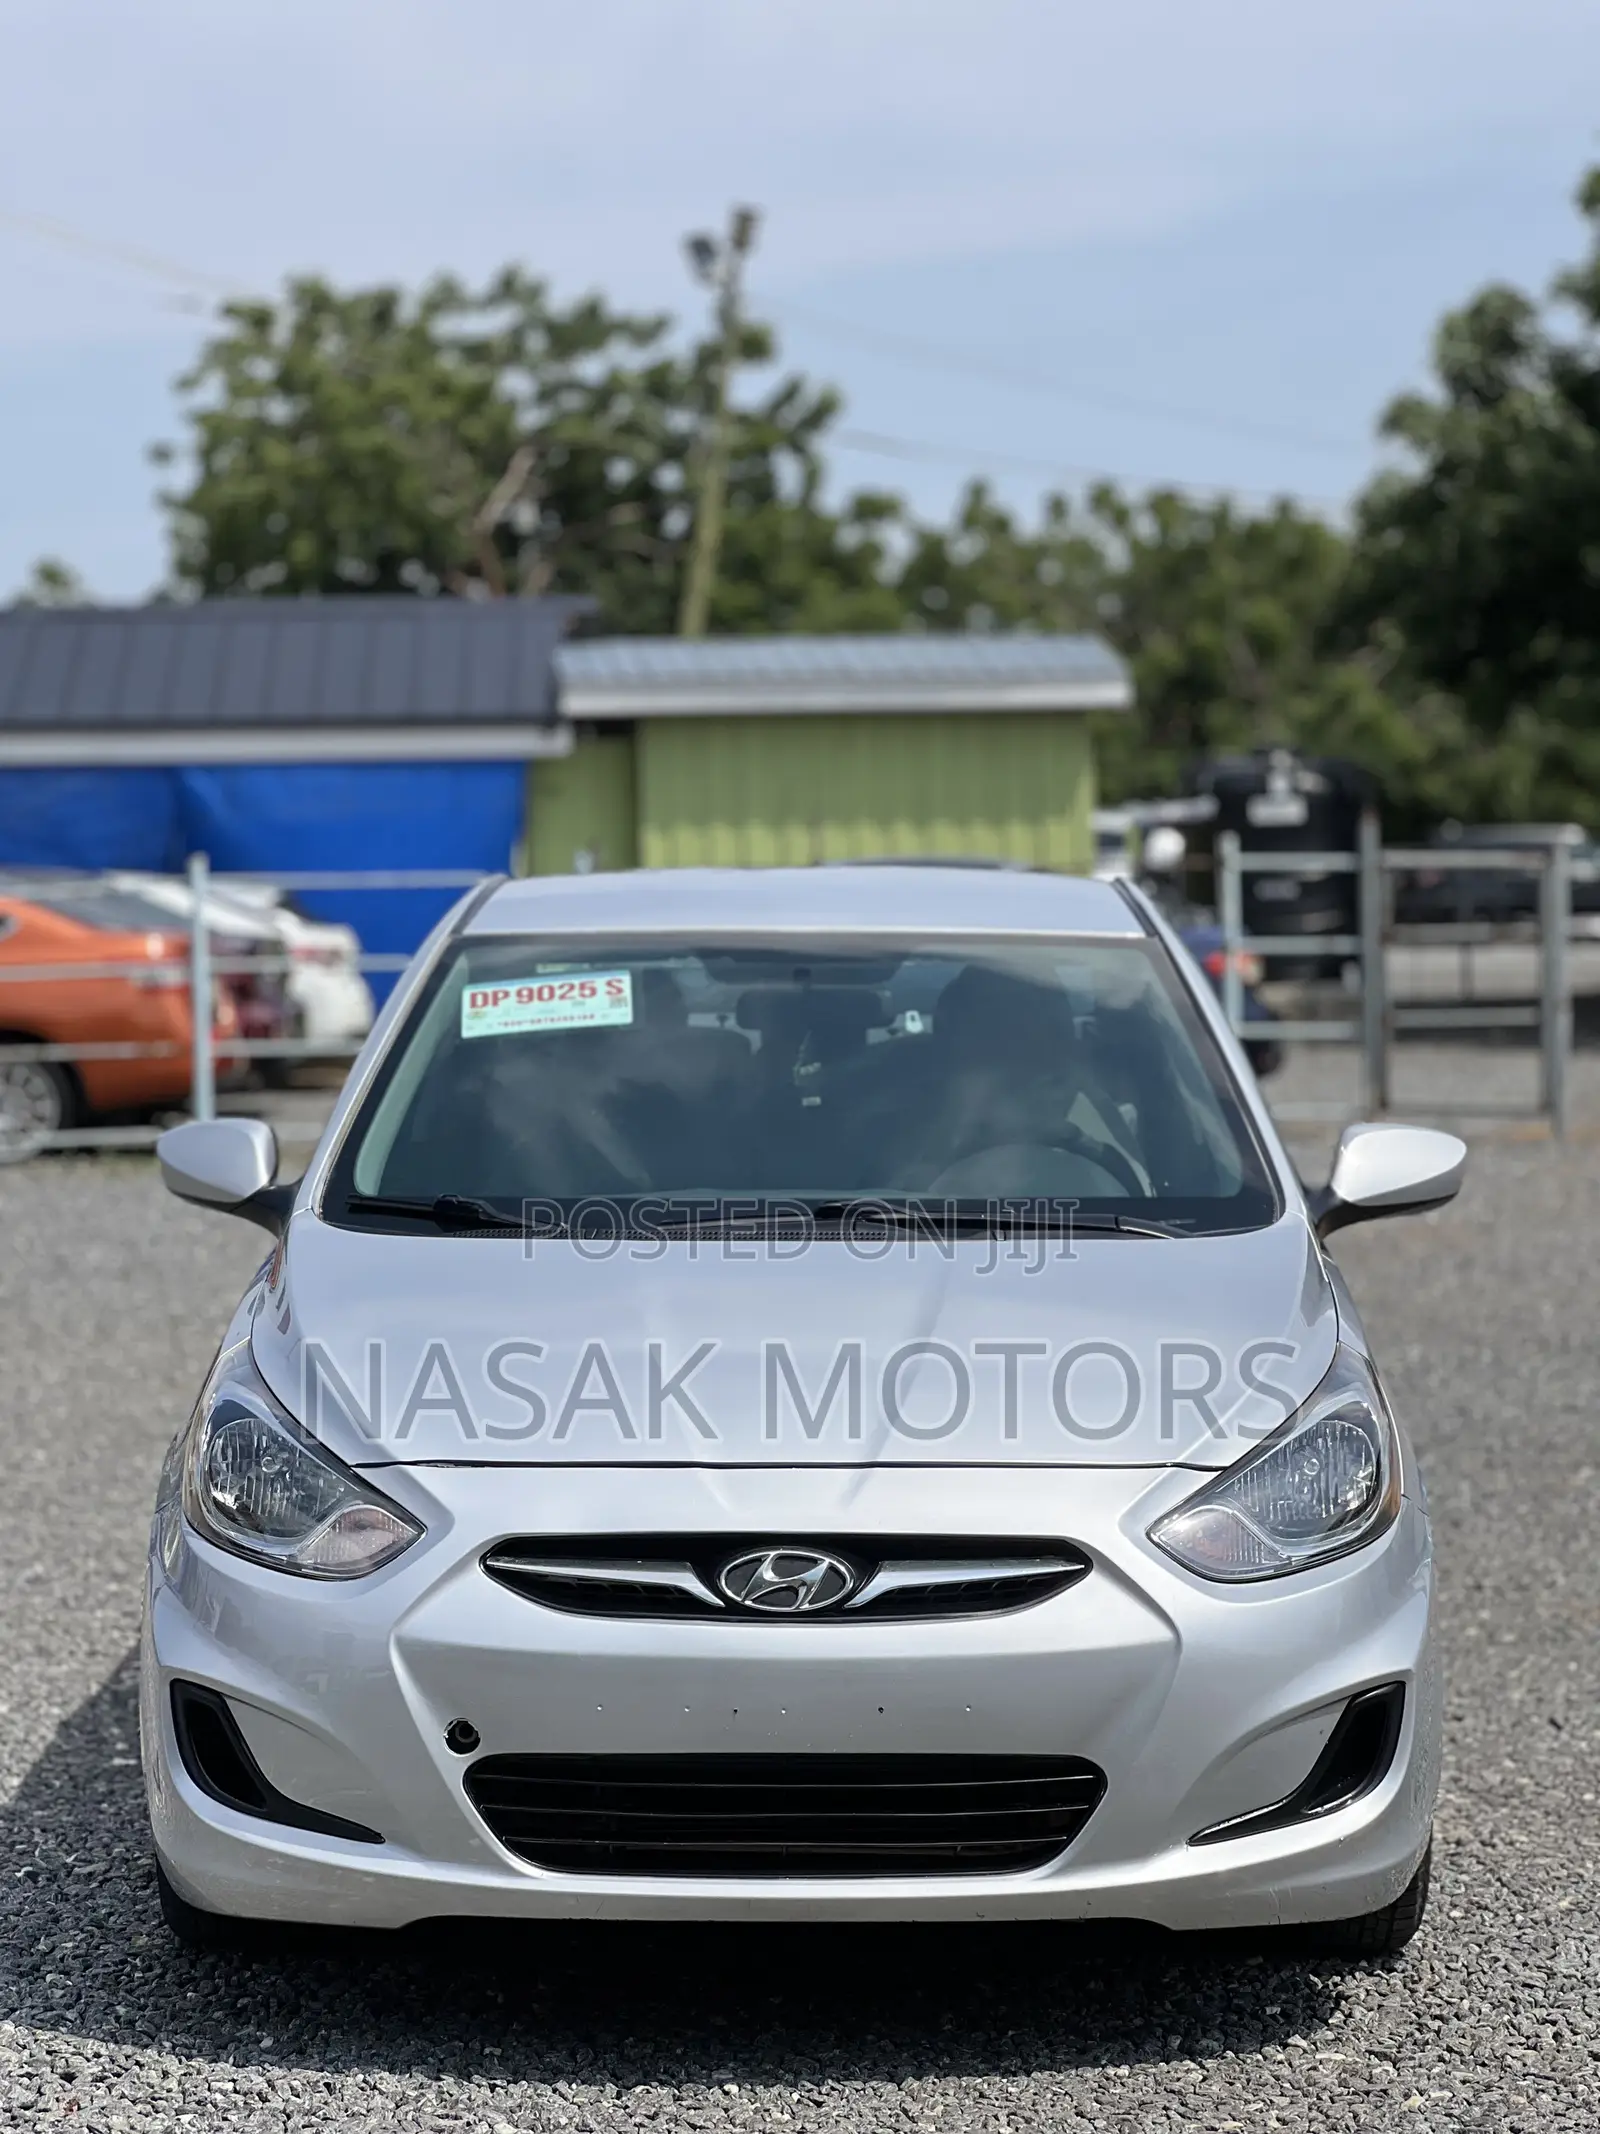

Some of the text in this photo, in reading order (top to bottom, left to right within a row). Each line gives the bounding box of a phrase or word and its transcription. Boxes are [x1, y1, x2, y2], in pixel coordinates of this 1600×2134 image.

[470, 978, 624, 1008] DP 9025 S
